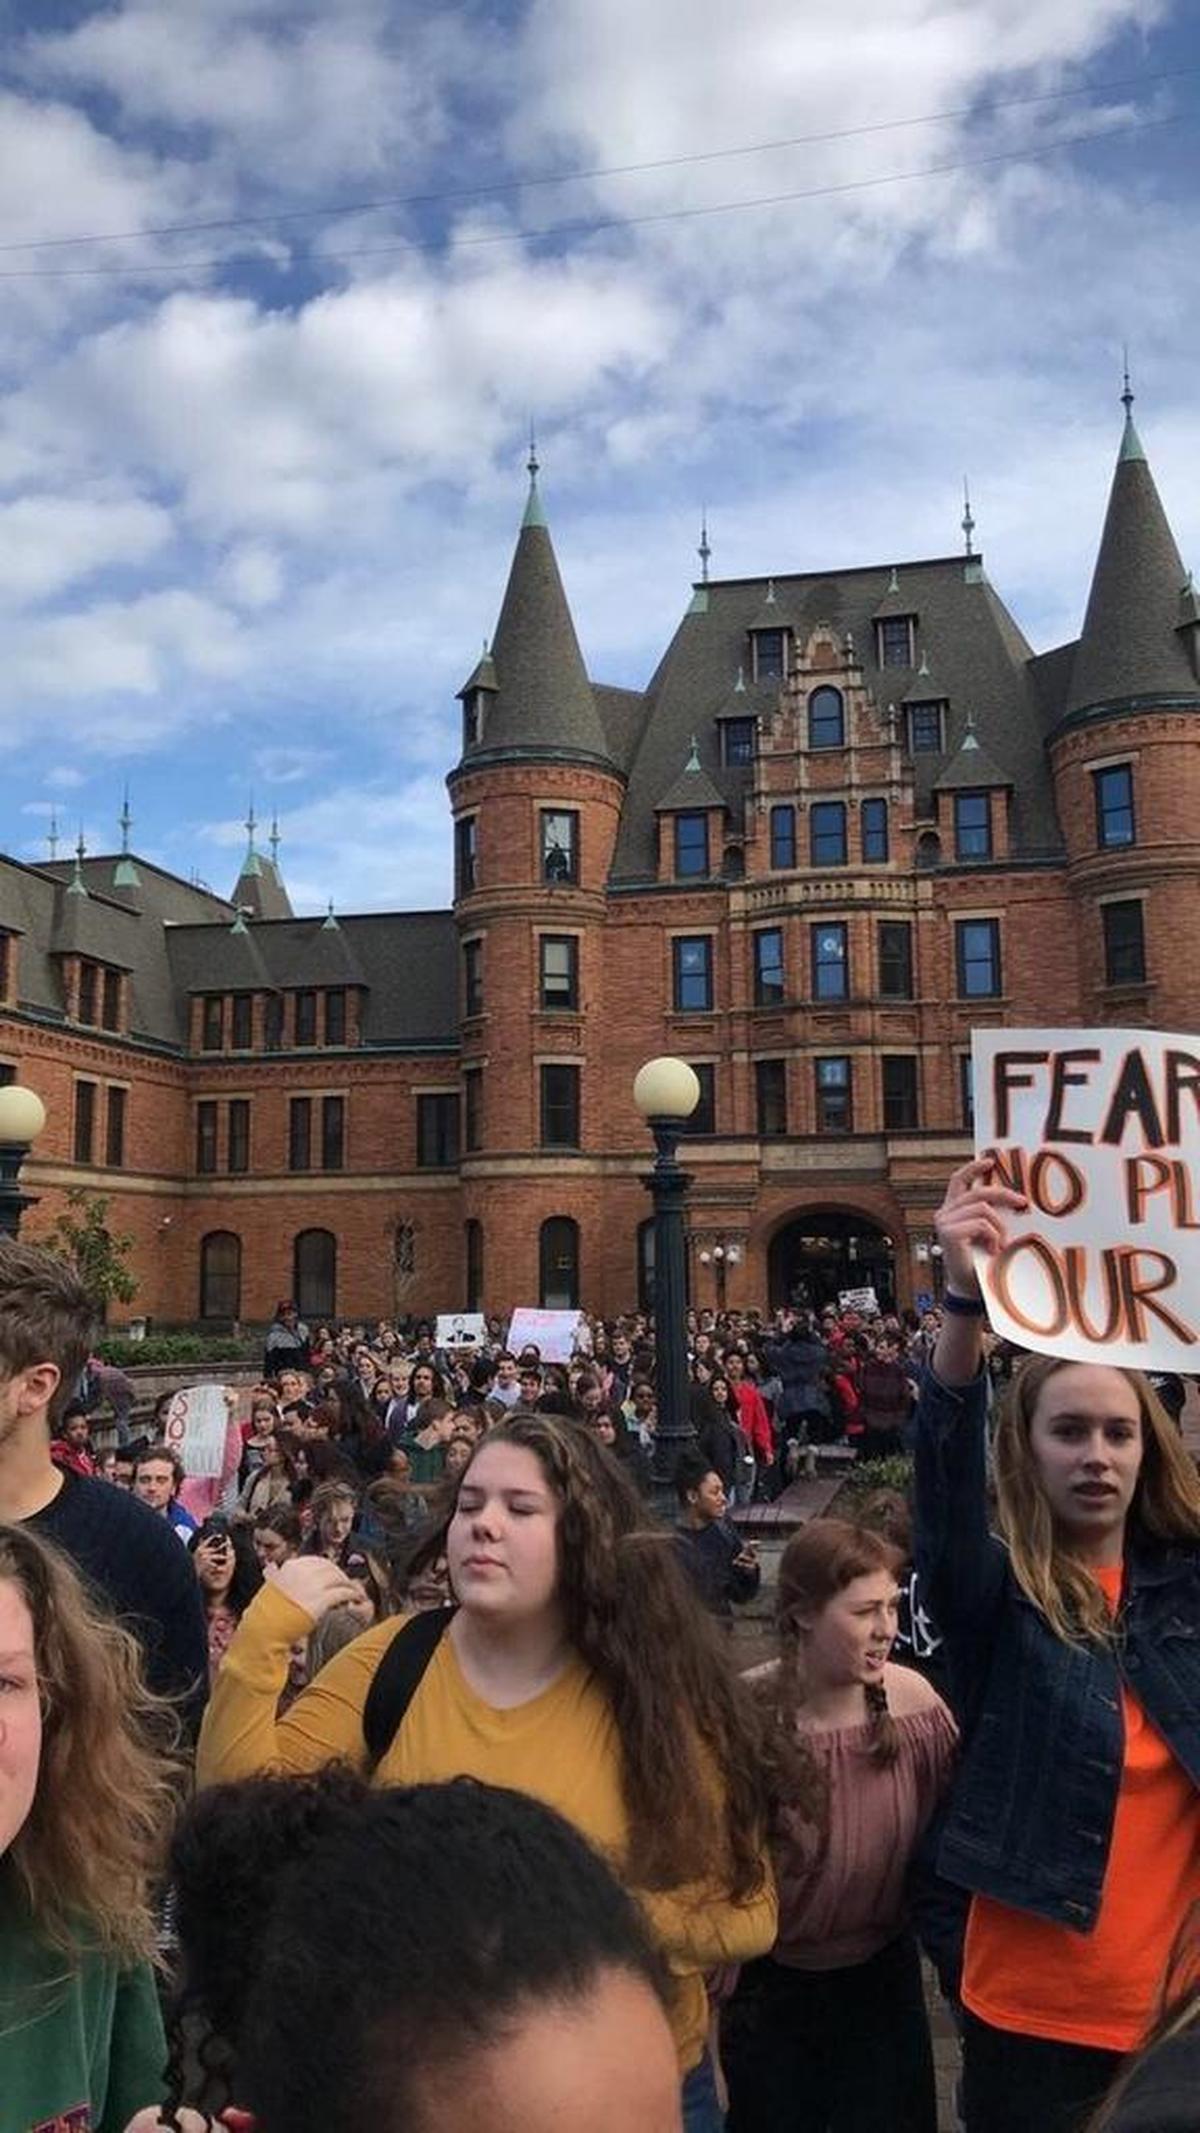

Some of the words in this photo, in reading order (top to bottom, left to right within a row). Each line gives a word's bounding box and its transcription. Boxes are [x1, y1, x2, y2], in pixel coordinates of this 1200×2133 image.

[993, 1046, 1200, 1149] FEAR
[980, 1147, 1086, 1218] NO
[985, 1231, 1199, 1345] OUR
